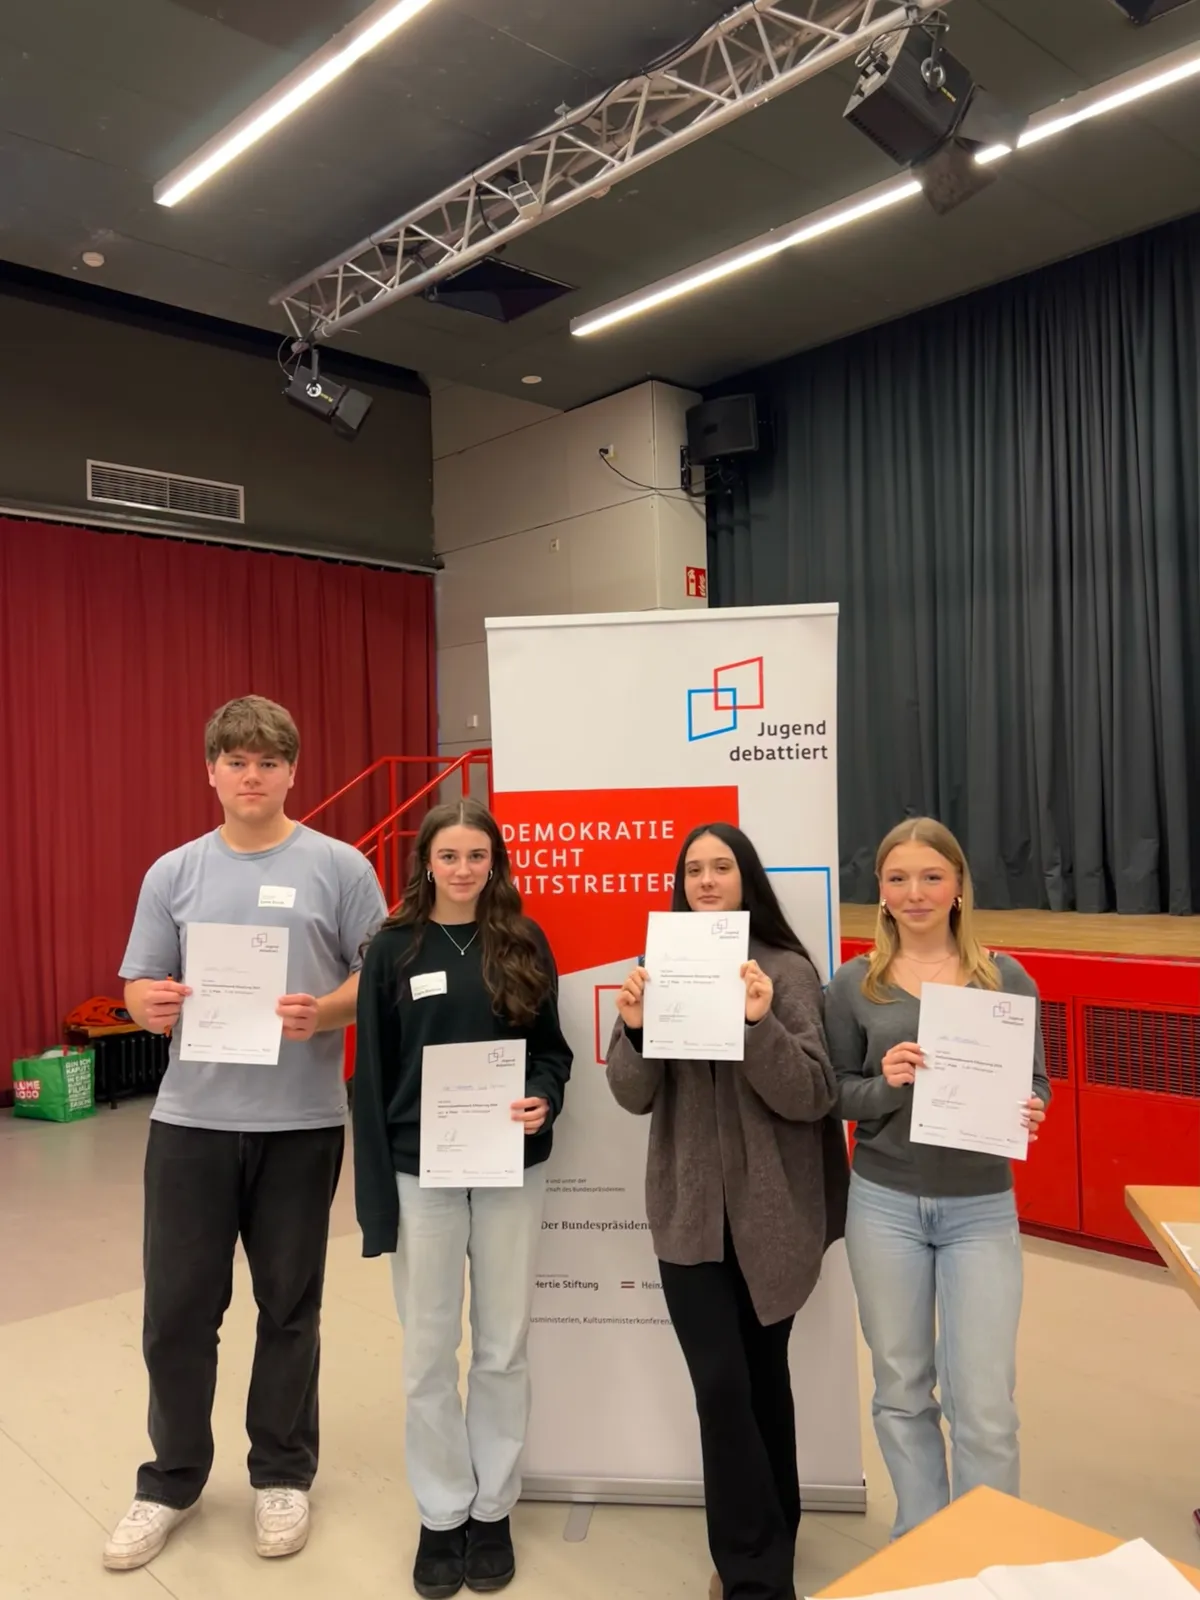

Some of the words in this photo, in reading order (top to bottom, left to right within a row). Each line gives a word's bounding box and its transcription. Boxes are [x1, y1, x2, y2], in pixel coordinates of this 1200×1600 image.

[757, 720, 826, 739] Jugend
[729, 743, 828, 761] debattiert
[502, 820, 674, 843] DEMOKRATIE
[541, 1221, 559, 1230] Der
[562, 1279, 599, 1291] Stiftung
